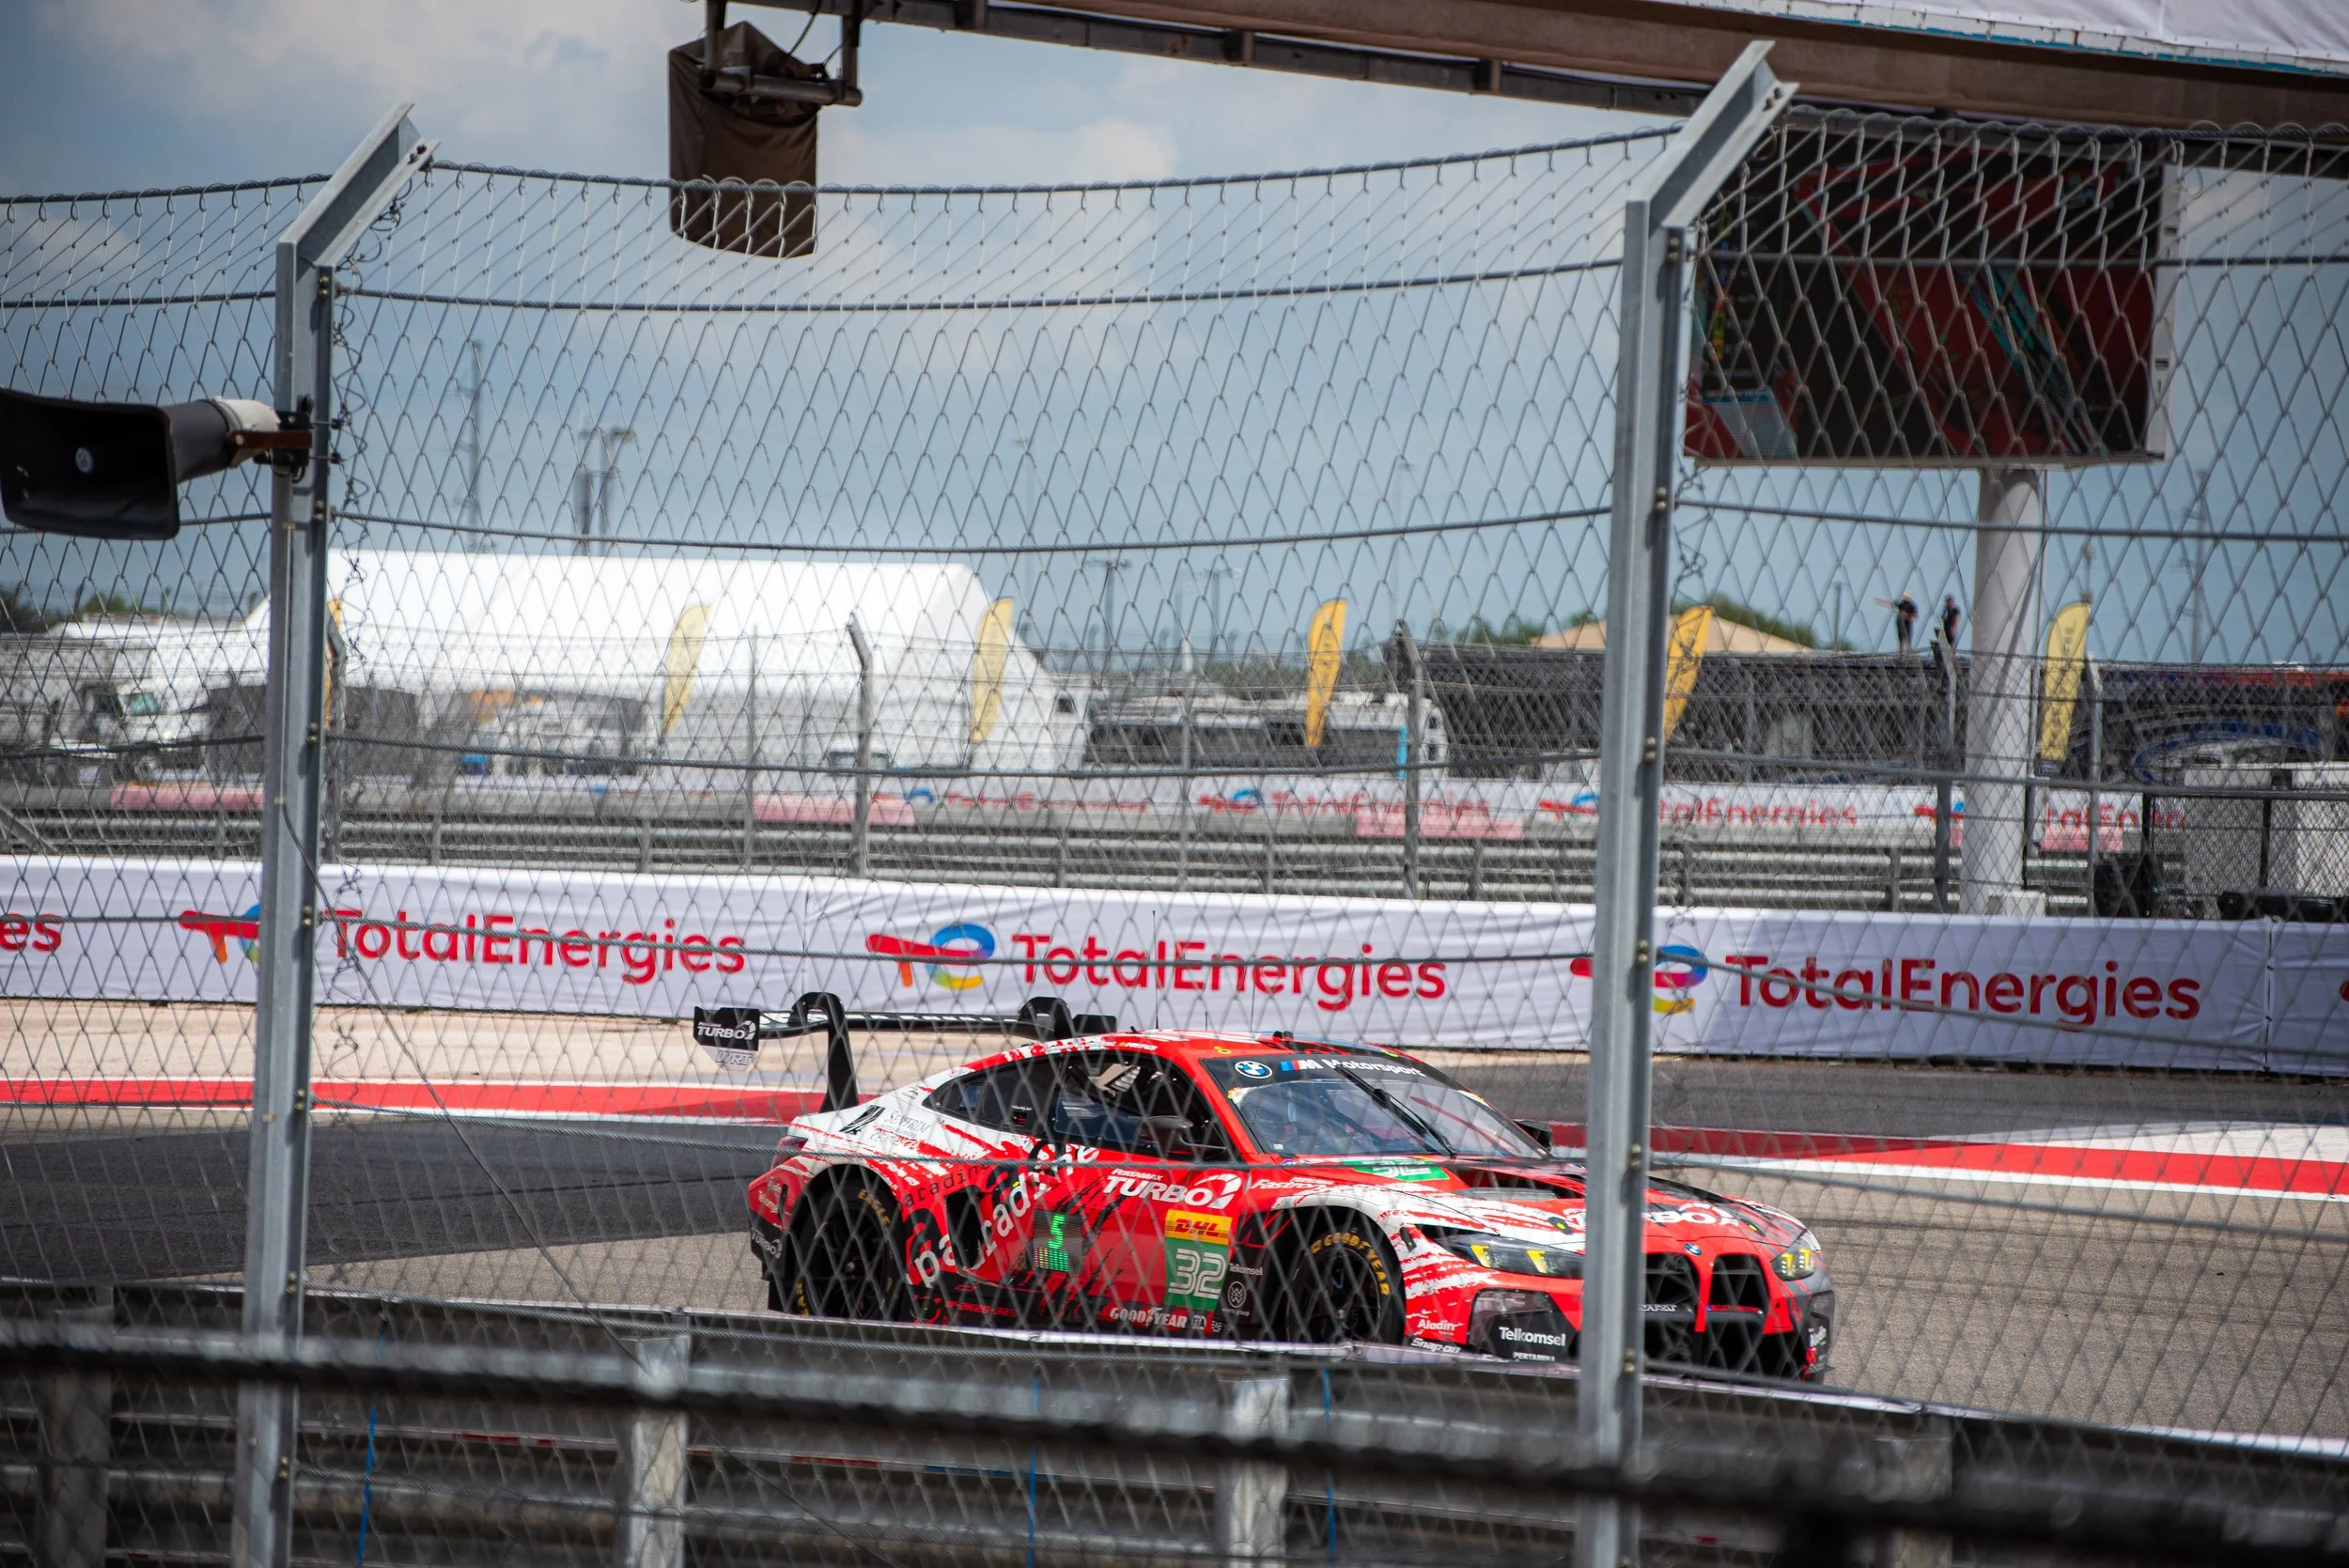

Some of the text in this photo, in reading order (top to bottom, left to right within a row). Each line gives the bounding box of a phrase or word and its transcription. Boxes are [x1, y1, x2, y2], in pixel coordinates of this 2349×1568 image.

[324, 909, 746, 985] TotalEnergies
[1012, 935, 1446, 1011] TotalEnergies
[1725, 955, 2201, 1032] TotalEnergies
[1321, 1059, 1426, 1078] Motorsport
[1103, 1175, 1215, 1206] TURBO
[1175, 1219, 1221, 1237] DHL
[1167, 1248, 1227, 1300] 32
[1310, 1232, 1390, 1296] GOODYEAR
[1110, 1308, 1188, 1328] GOODYEAR
[1410, 1338, 1462, 1354] Snap-on
[1499, 1326, 1566, 1346] Telkomsel
